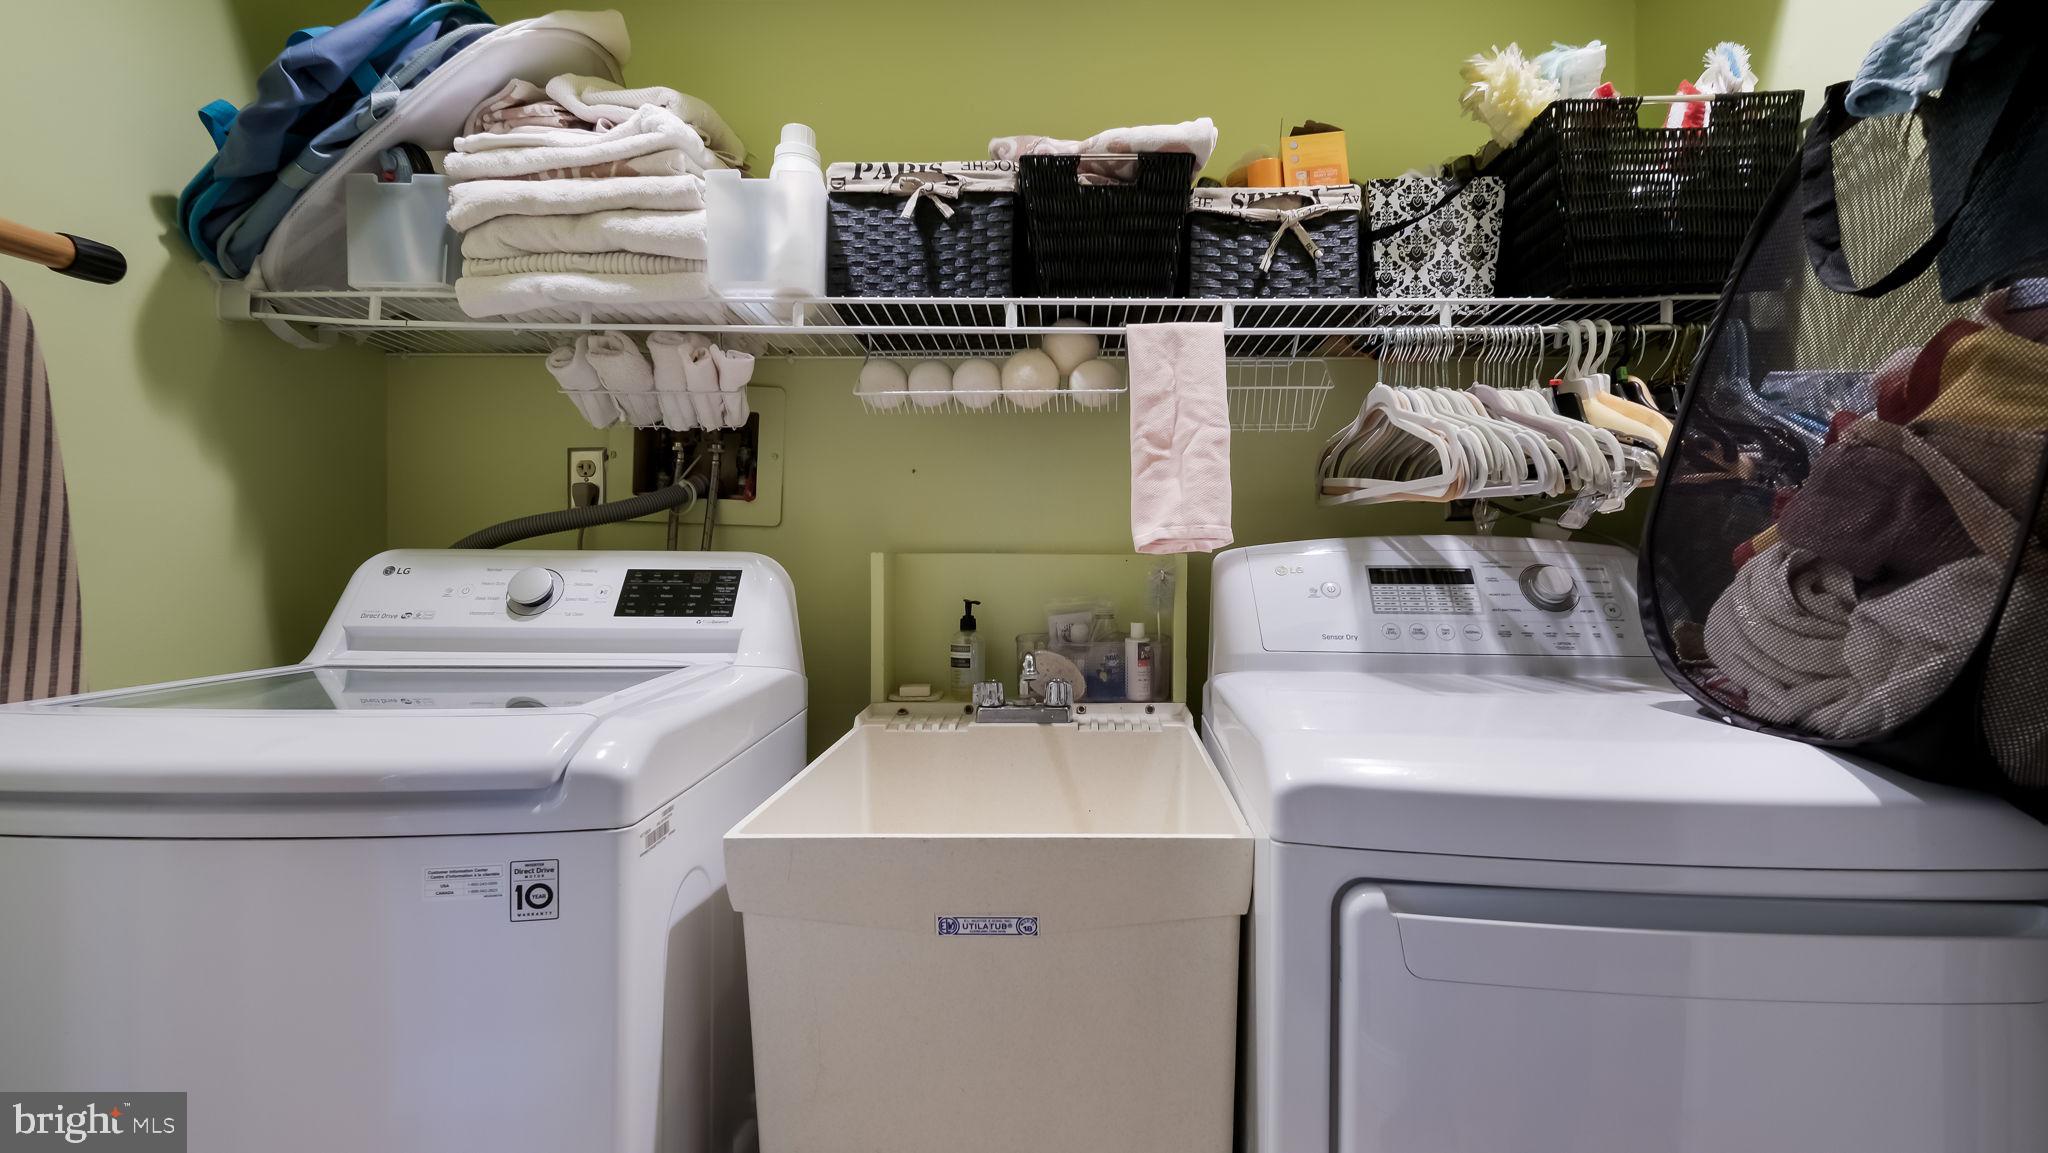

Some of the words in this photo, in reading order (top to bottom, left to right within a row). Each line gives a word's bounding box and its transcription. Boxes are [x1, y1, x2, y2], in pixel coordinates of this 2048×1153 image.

[396, 567, 412, 575] LG
[1289, 566, 1304, 574] LG
[1346, 634, 1359, 642] Dry
[515, 883, 553, 910] 10
